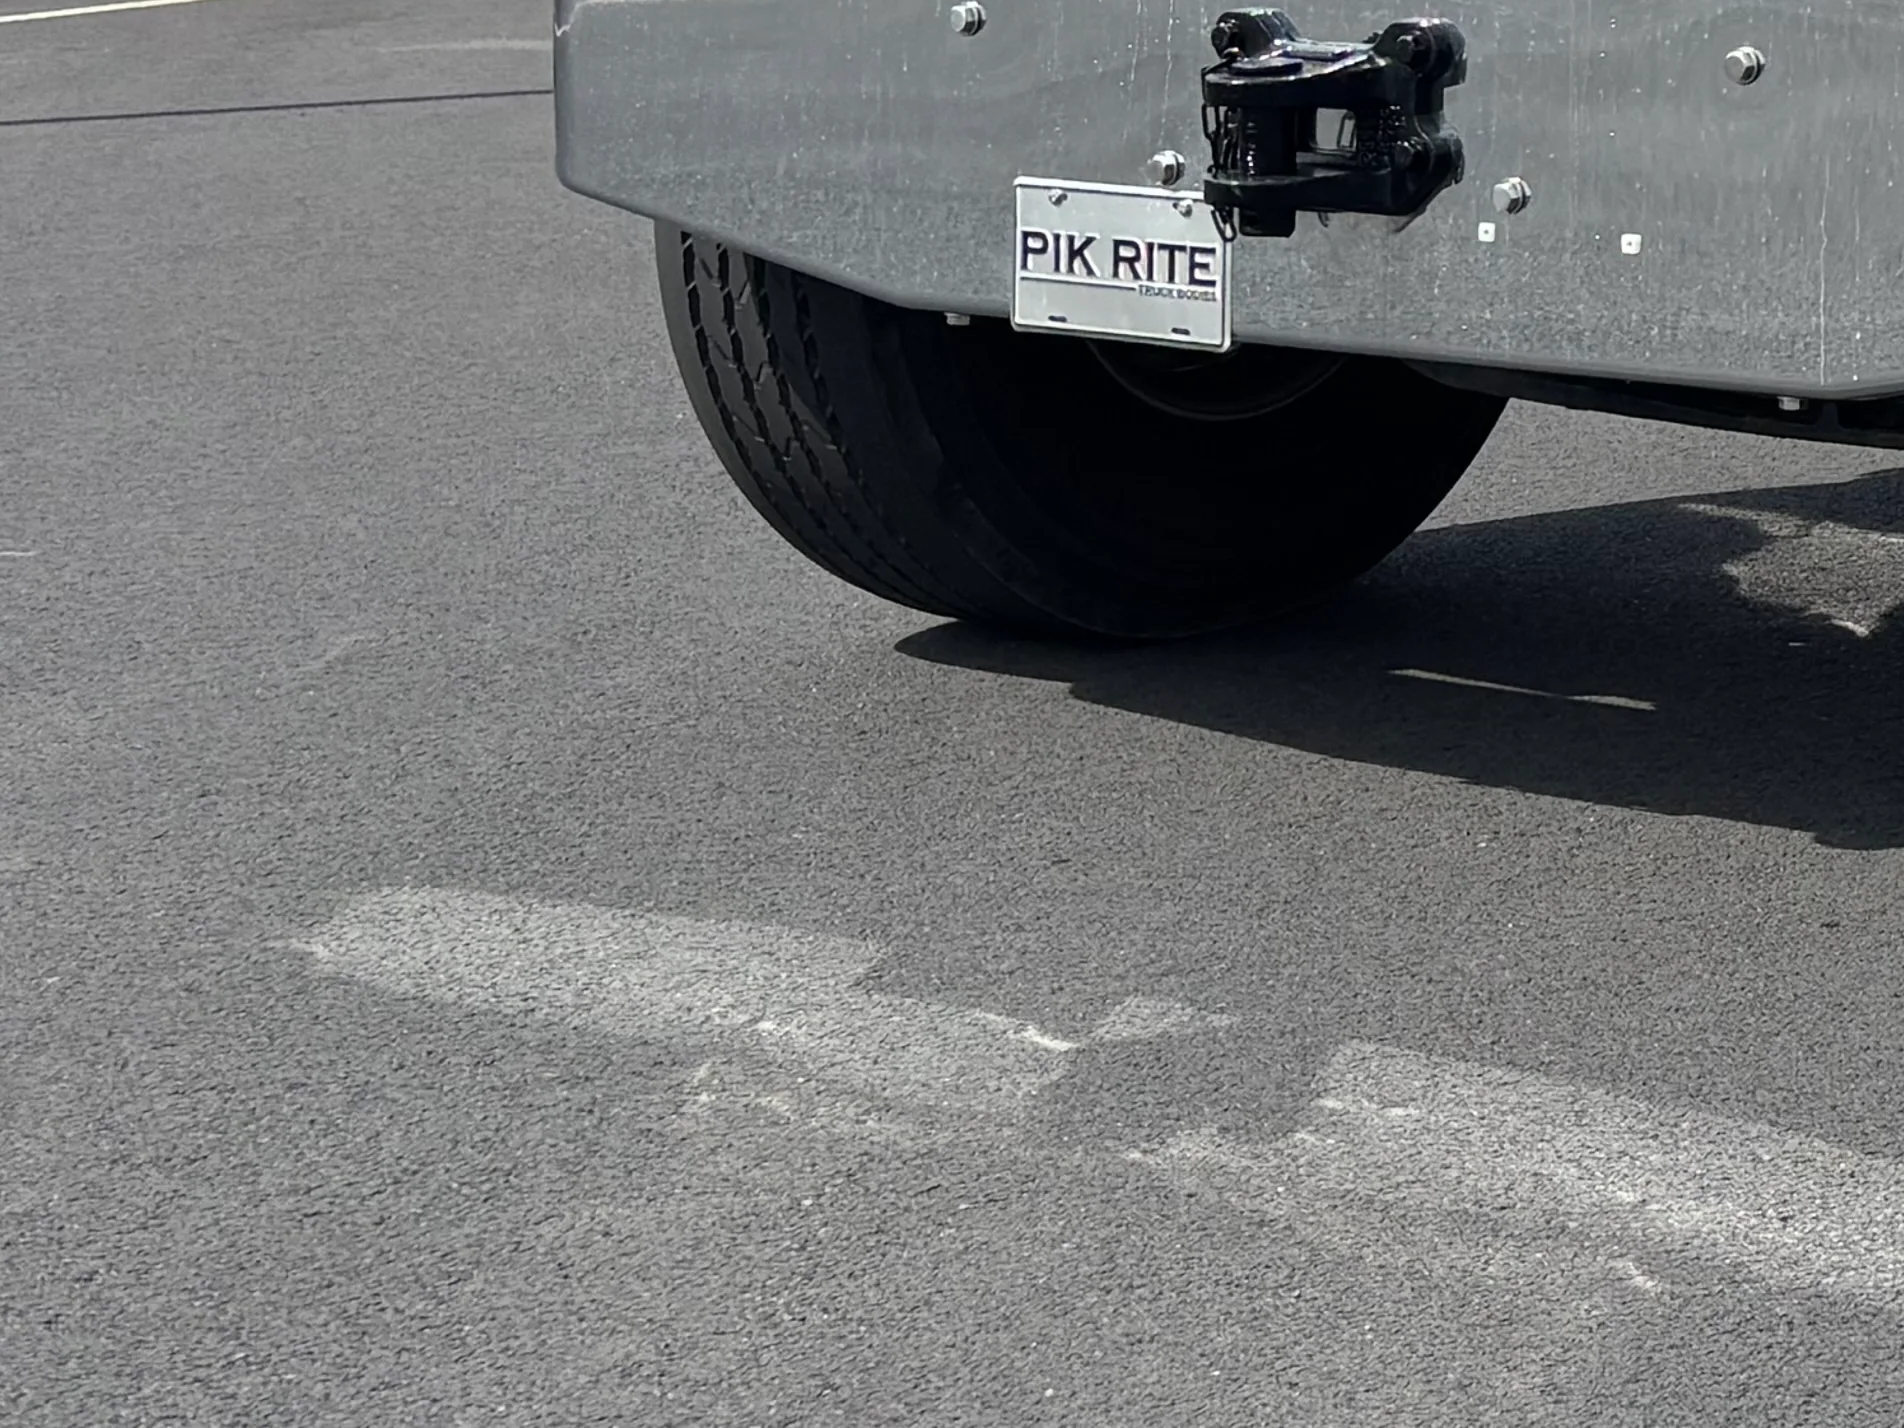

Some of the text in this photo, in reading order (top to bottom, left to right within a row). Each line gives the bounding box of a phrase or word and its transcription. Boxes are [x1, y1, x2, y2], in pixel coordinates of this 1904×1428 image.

[1020, 228, 1217, 287] PIK RITE
[1138, 284, 1175, 298] TRUCK
